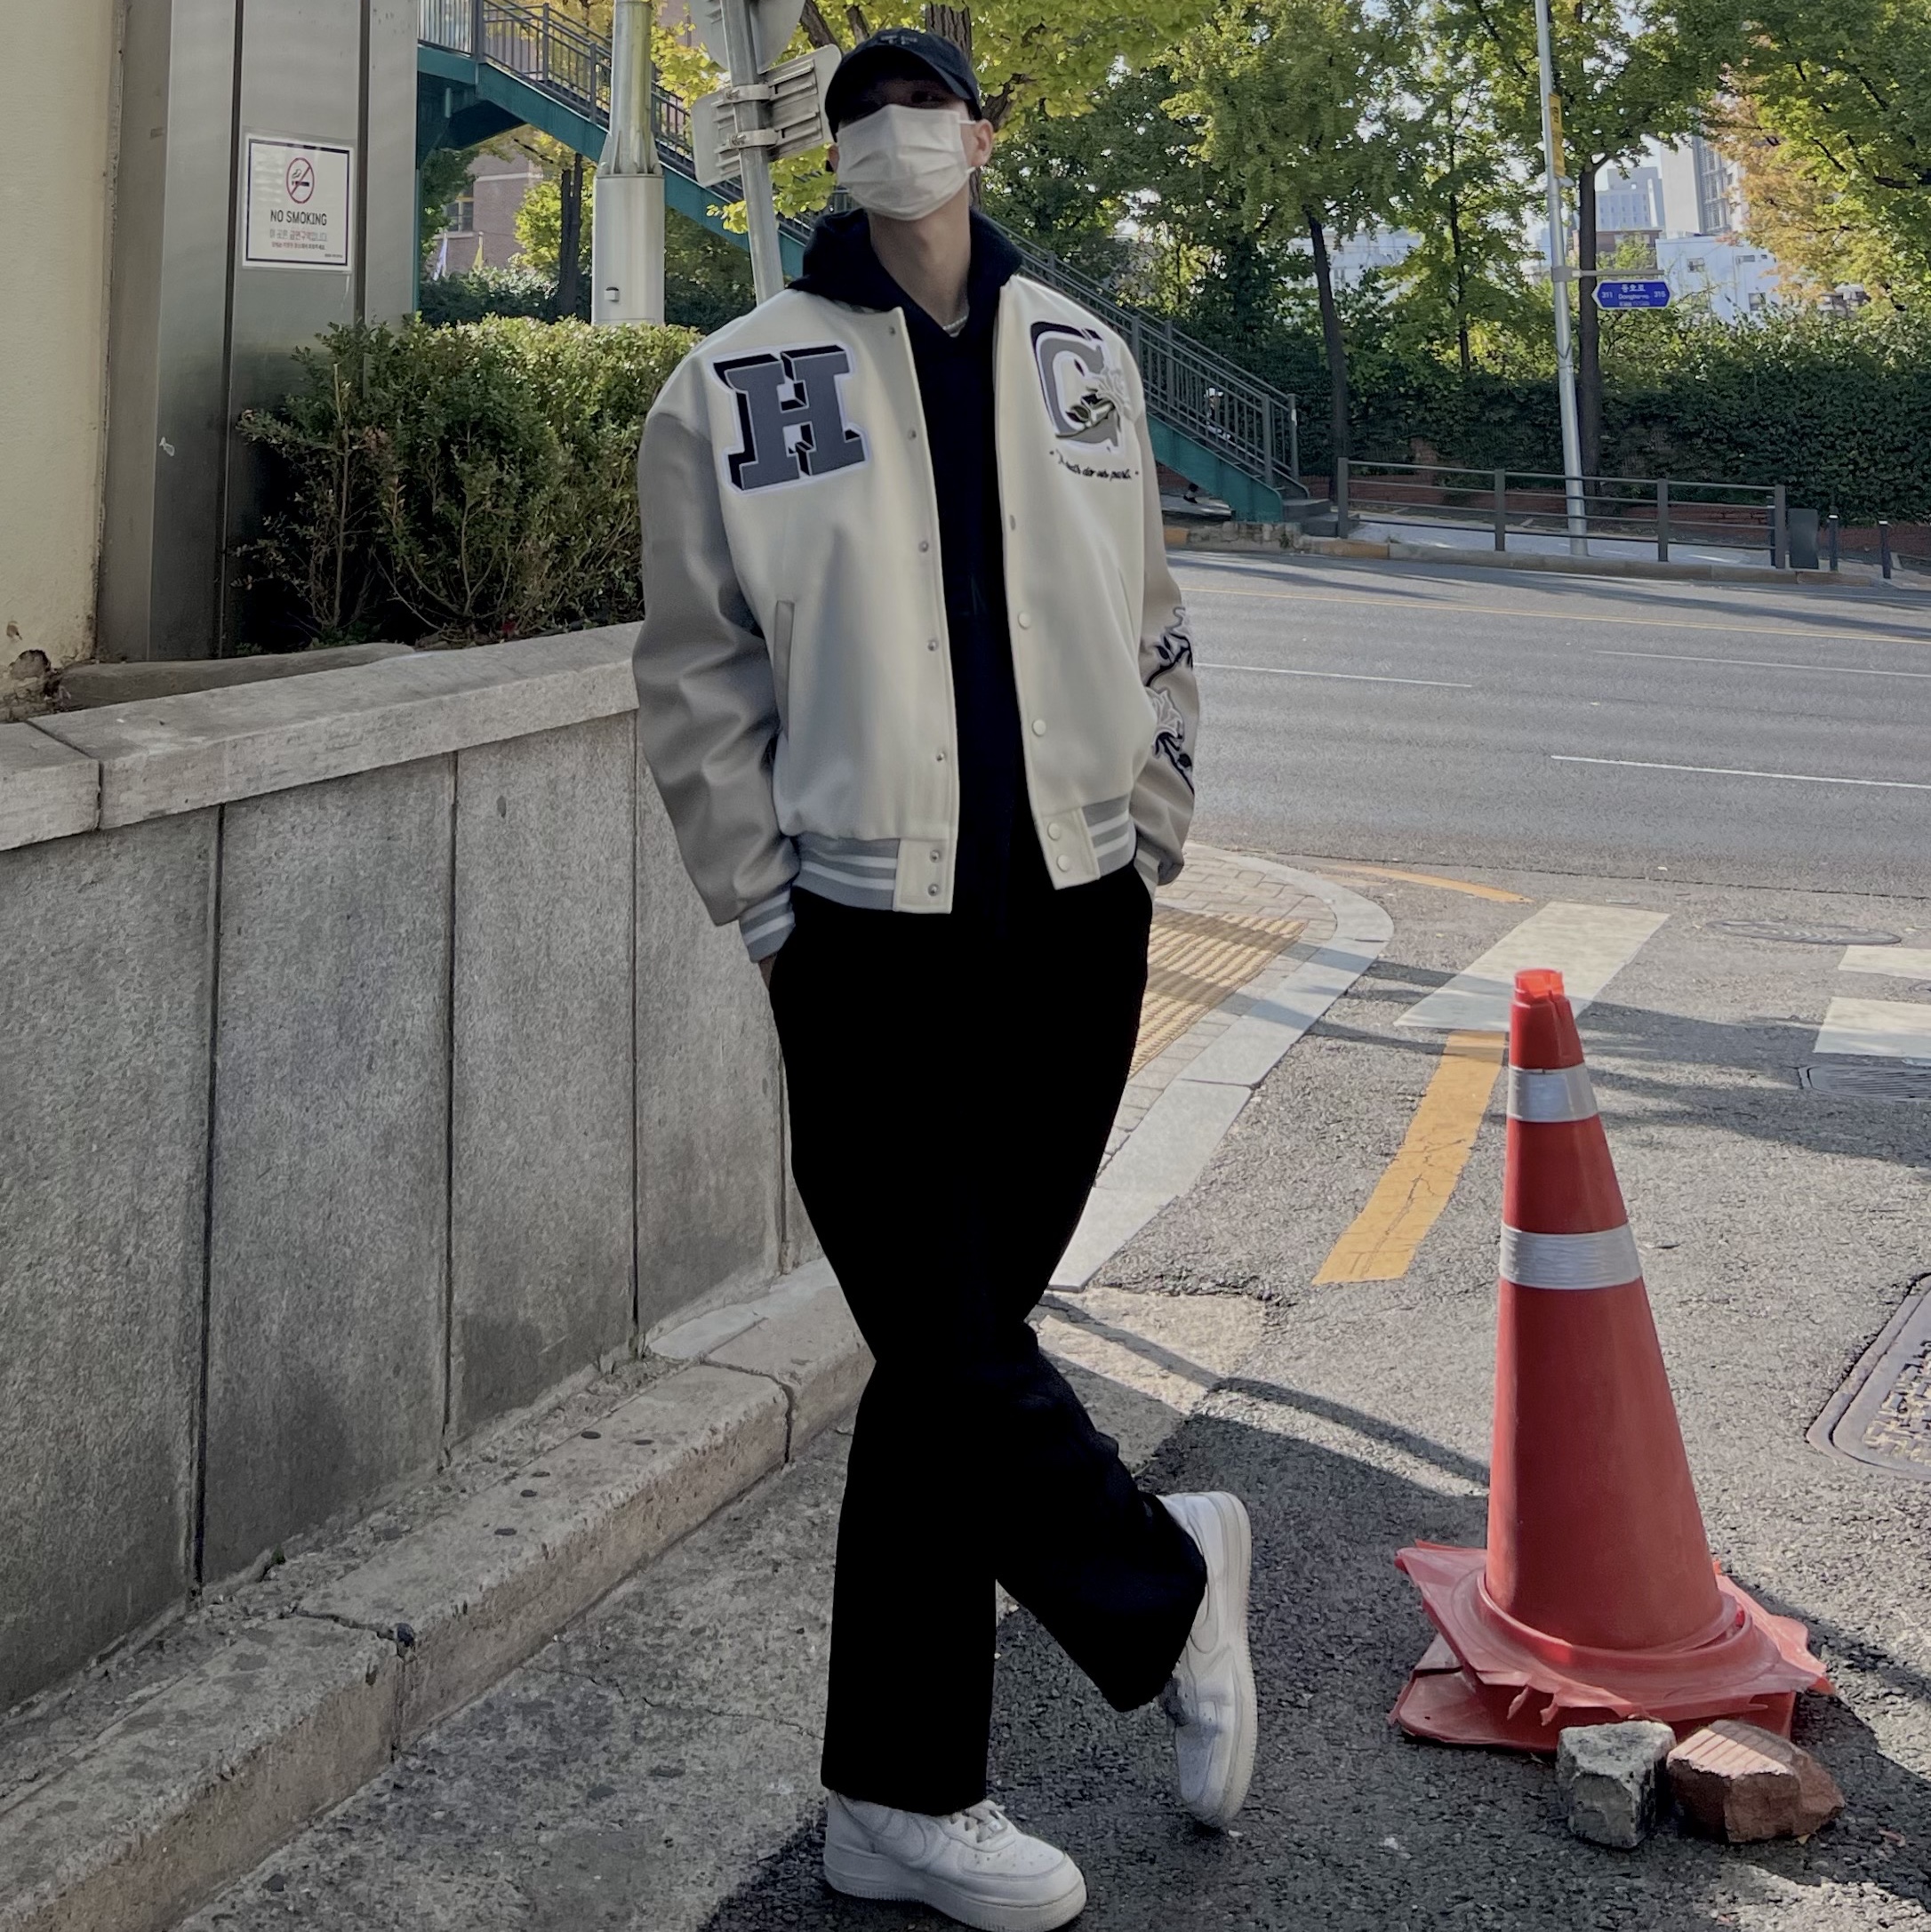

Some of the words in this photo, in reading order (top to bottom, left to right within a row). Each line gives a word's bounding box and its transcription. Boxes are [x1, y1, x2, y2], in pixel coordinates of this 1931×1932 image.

[270, 209, 284, 222] NO
[286, 210, 327, 226] SMOKING
[712, 343, 867, 492] H
